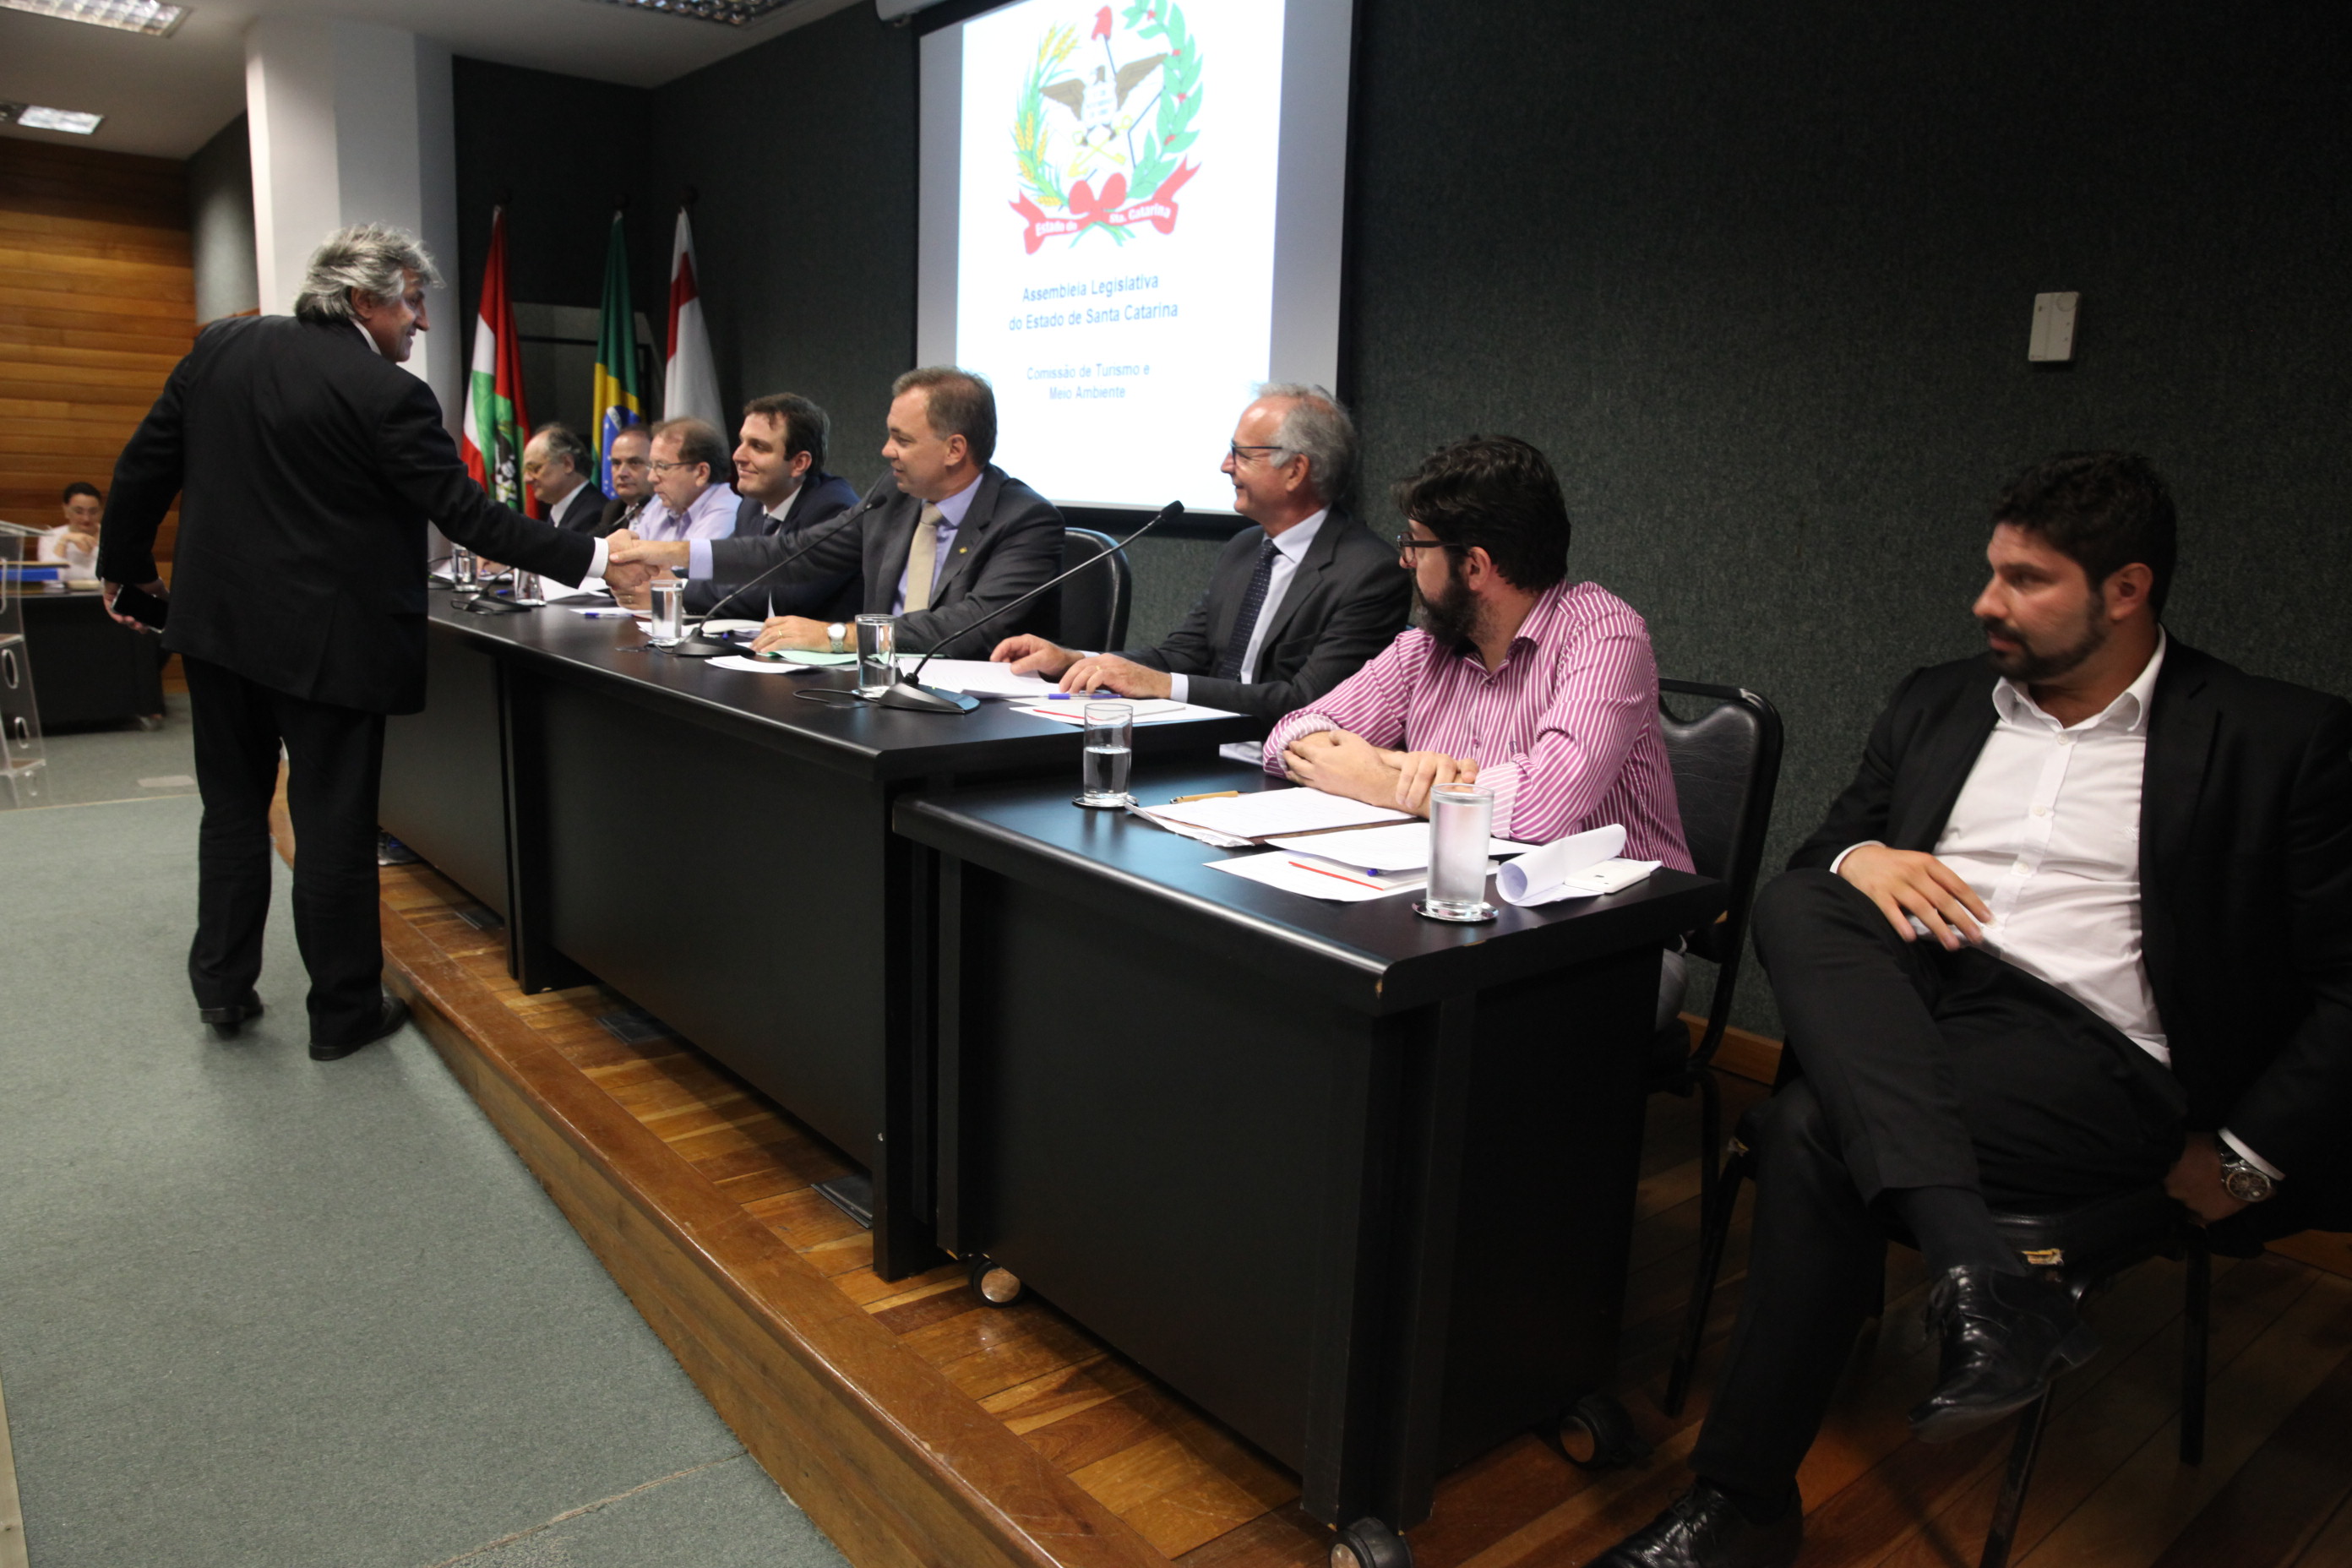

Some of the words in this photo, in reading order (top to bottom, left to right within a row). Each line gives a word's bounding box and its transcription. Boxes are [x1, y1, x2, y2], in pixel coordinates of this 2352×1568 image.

[1035, 220, 1065, 237] Estado
[1128, 203, 1171, 220] Catarina
[1022, 282, 1087, 302] Assembleia
[1091, 274, 1158, 297] Legislativa
[1009, 317, 1022, 331] do
[1026, 312, 1064, 329] Estado
[1068, 310, 1082, 325] de
[1086, 308, 1120, 324] Santa
[1124, 302, 1179, 321] Catarina
[1026, 364, 1075, 380] Comissão
[1079, 365, 1092, 378] de
[1096, 362, 1140, 378] Turismo
[1143, 364, 1150, 375] e
[1049, 386, 1072, 400] Meio
[1075, 385, 1125, 399] Ambiente
